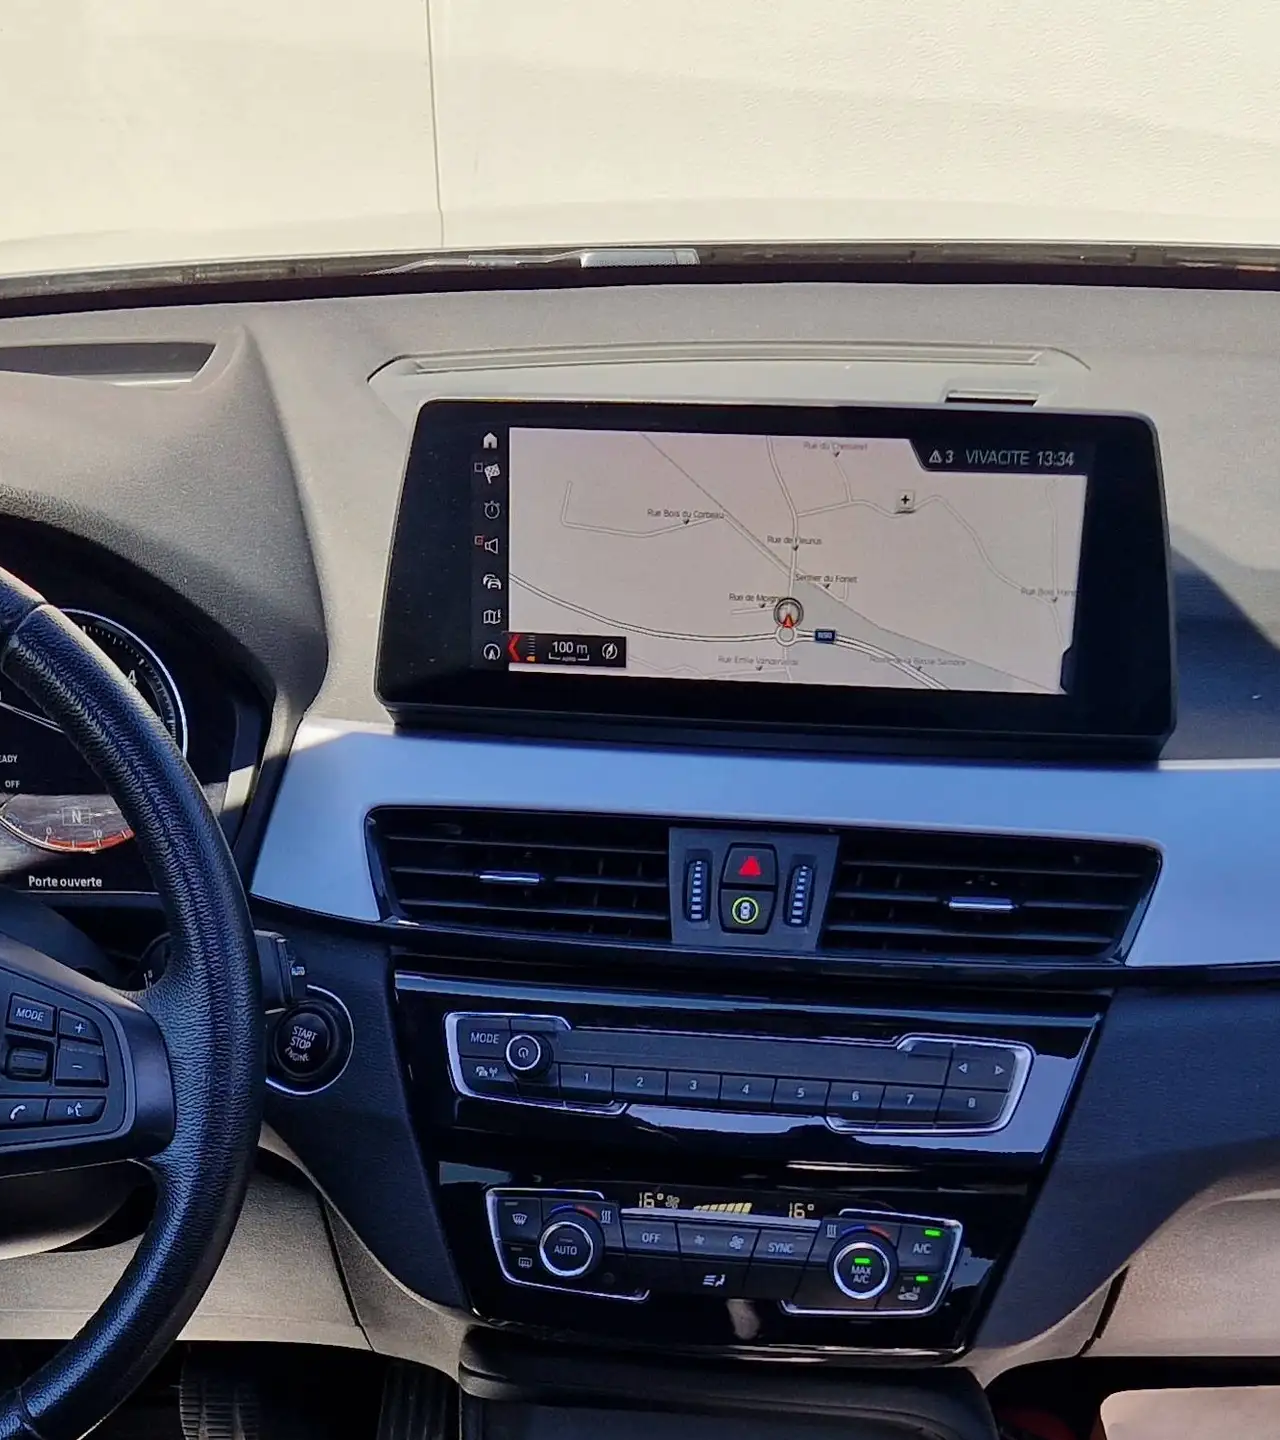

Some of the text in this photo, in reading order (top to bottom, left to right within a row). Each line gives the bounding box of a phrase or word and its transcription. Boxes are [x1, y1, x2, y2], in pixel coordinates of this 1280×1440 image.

[945, 450, 1074, 467] 3 VIVACITE 13:34
[552, 641, 588, 654] 100 m
[5, 780, 20, 788] OFF
[28, 875, 102, 888] Porte ouverte
[16, 1007, 45, 1022] MODE
[292, 1025, 318, 1042] START
[470, 1031, 500, 1045] MODE
[290, 1035, 312, 1050] STOP
[584, 1073, 590, 1083] 1
[636, 1076, 644, 1088] 2
[690, 1079, 697, 1090] 3
[742, 1083, 750, 1095] 4
[797, 1087, 805, 1098] 5
[852, 1090, 859, 1102] 6
[907, 1093, 914, 1105] 7
[641, 1232, 661, 1244] OFF
[553, 1244, 578, 1257] AUTO
[768, 1242, 794, 1254] SYNC
[912, 1242, 932, 1255] A/C
[851, 1265, 872, 1275] MAX
[853, 1275, 870, 1284] A/C
